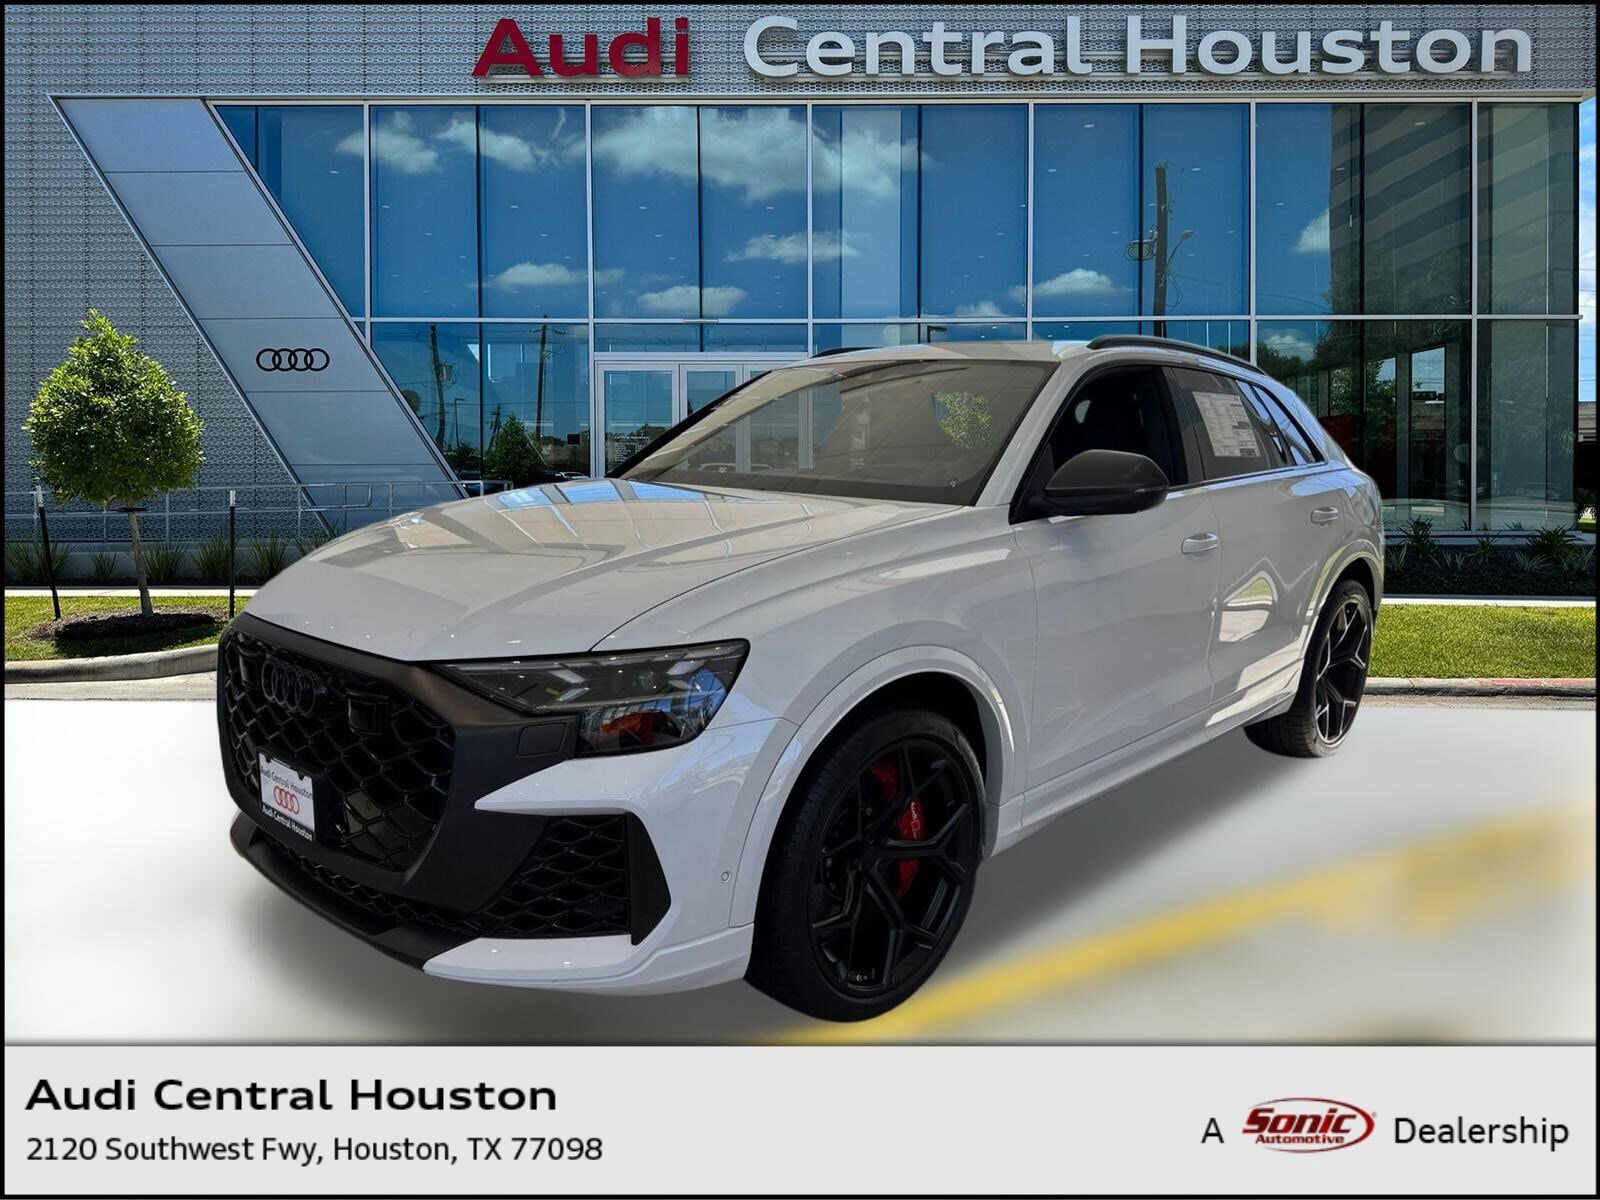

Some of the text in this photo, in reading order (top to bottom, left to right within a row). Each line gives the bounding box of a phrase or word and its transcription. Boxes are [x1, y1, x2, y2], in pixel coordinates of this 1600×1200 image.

[471, 14, 1532, 78] Audi Central Houston
[291, 821, 313, 842] Houston
